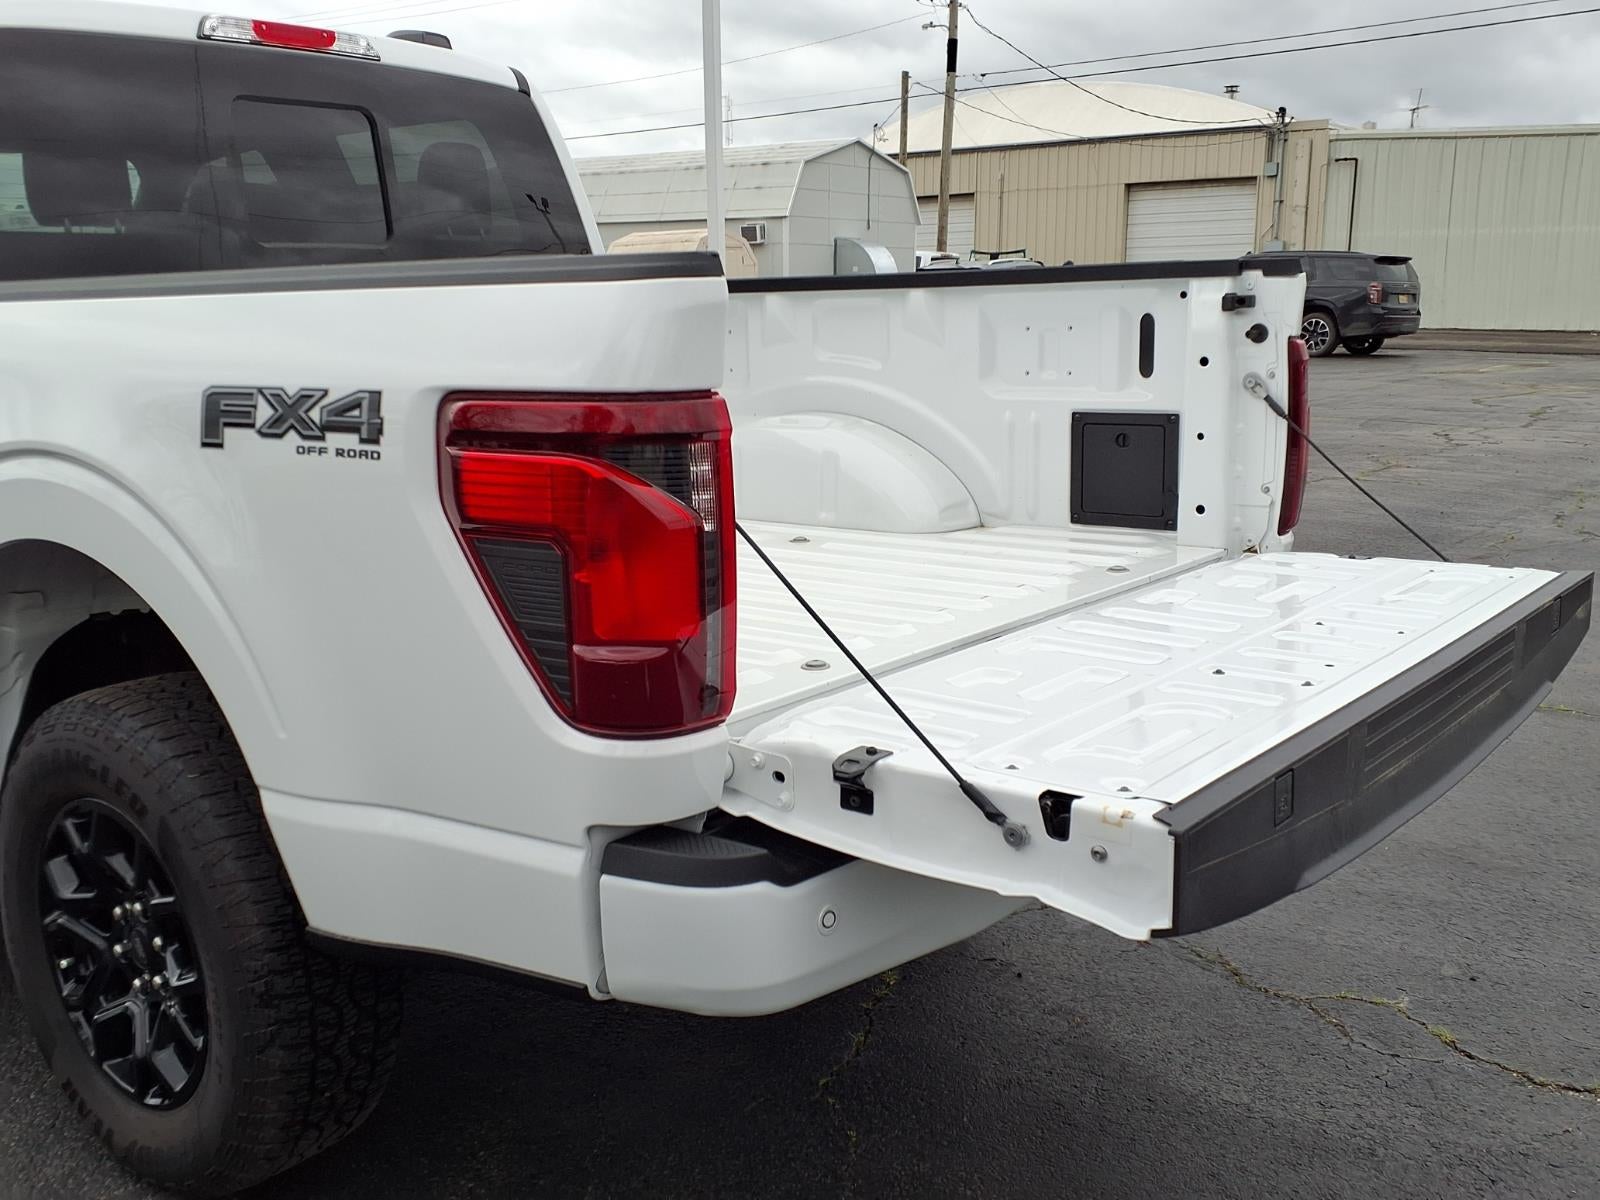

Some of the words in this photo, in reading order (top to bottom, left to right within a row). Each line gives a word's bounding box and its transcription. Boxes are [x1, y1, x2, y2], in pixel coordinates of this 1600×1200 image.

[200, 385, 384, 450] FX4
[296, 445, 329, 457] OFF
[335, 447, 381, 461] ROAD
